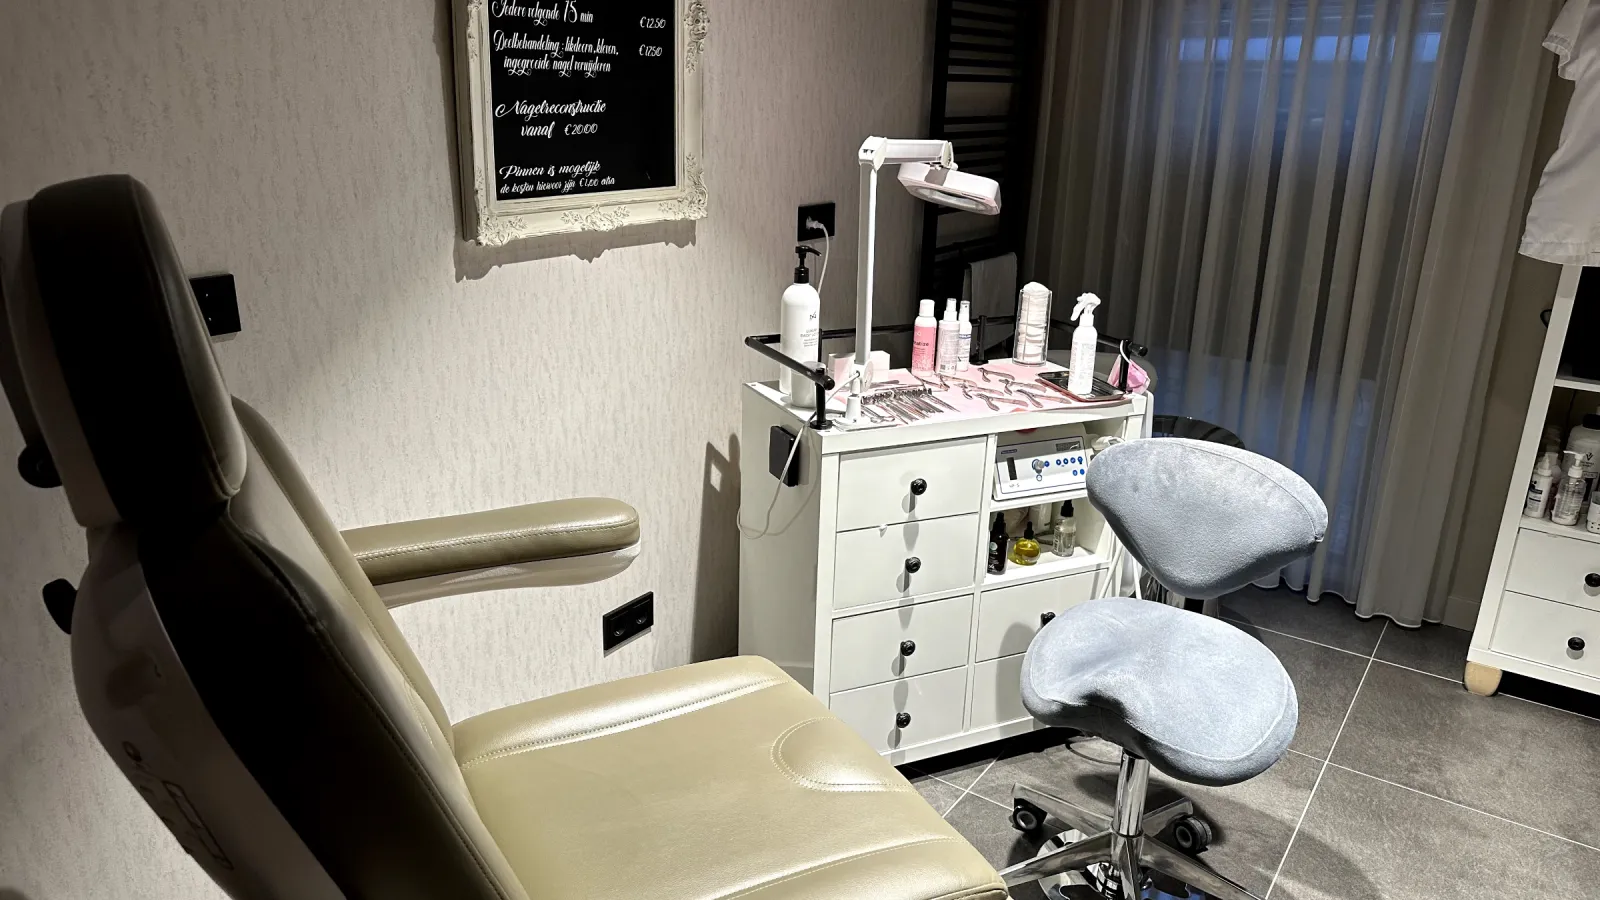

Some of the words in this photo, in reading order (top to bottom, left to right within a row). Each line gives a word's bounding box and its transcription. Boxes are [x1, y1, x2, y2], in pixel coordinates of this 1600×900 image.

[580, 11, 594, 24] min
[552, 55, 575, 78] nagel
[495, 99, 607, 122] Nagelreconstructie
[520, 121, 556, 139] vanaf
[499, 164, 545, 180] Pinnen
[547, 164, 556, 177] is
[558, 160, 602, 178] mogelijk
[500, 184, 510, 194] de
[511, 181, 535, 195] kosten
